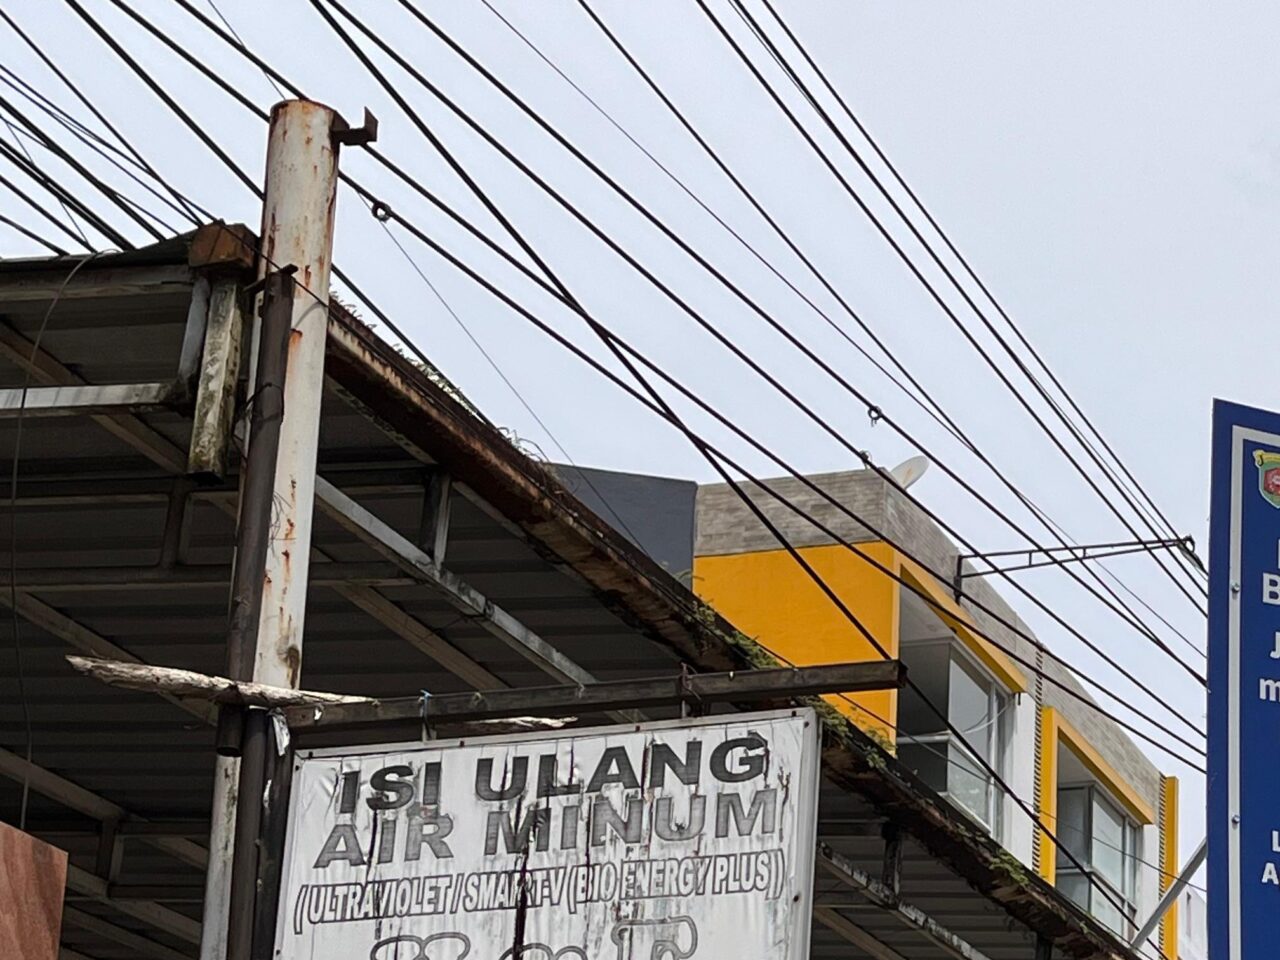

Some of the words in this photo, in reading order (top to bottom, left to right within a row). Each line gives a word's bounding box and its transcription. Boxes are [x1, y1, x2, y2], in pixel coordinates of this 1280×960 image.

[340, 761, 442, 815] ISI
[474, 736, 769, 802] ULANG
[313, 811, 454, 869] AIR
[483, 788, 779, 856] MINUM
[619, 855, 714, 899] ENERGY
